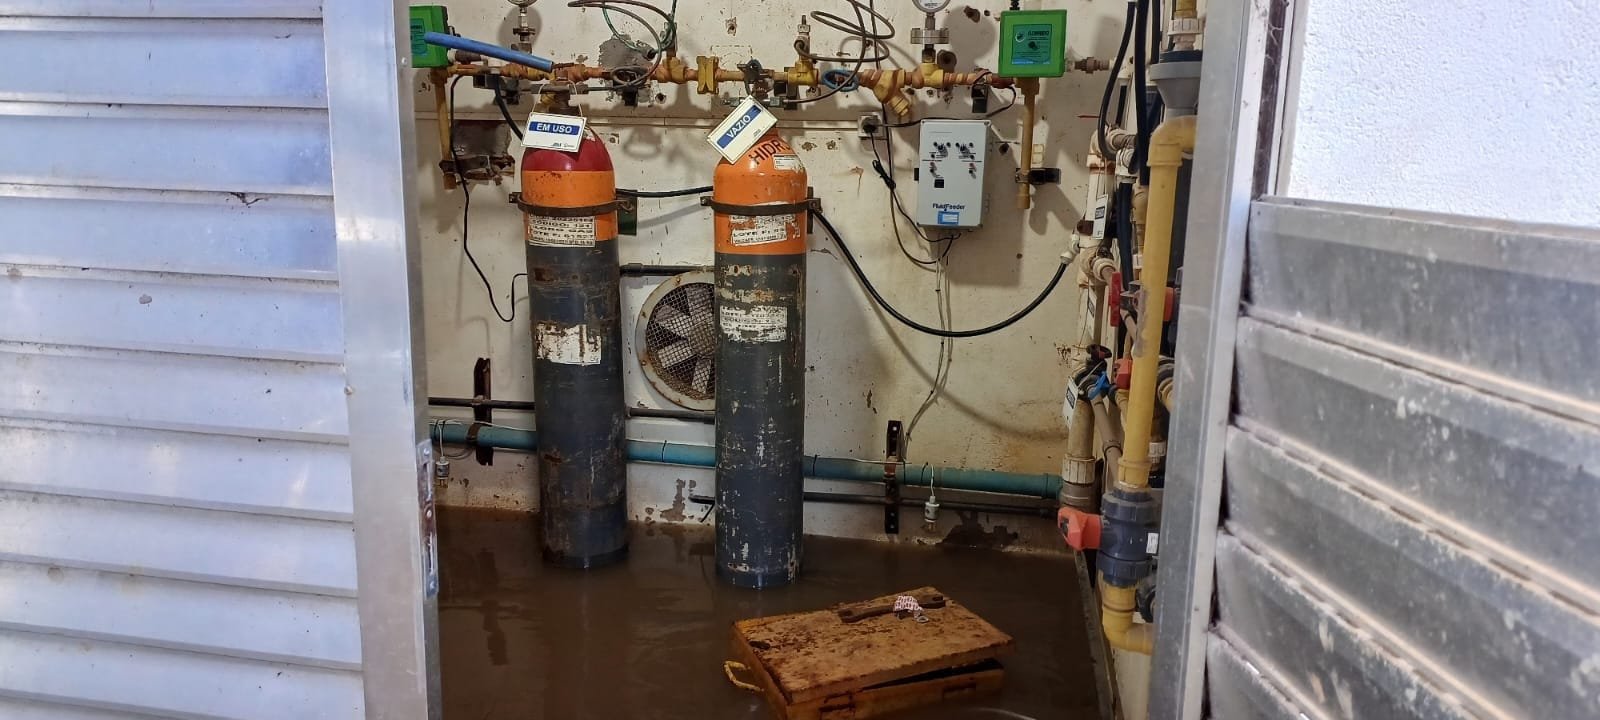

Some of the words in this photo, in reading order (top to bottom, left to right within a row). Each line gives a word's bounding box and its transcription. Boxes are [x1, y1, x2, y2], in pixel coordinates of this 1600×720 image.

[536, 123, 550, 131] EM
[552, 124, 573, 134] USO
[726, 115, 751, 138] VAZIO
